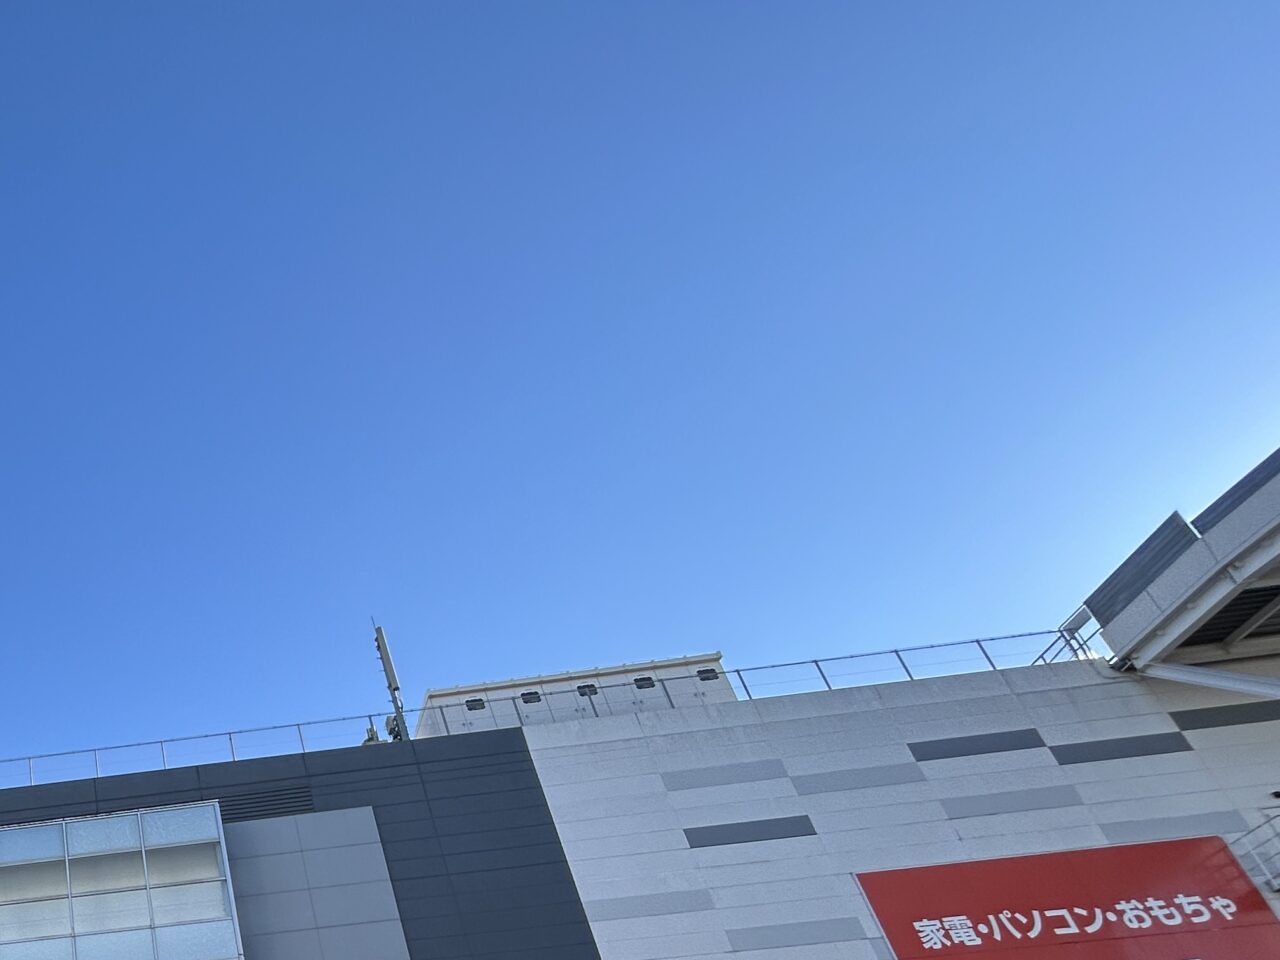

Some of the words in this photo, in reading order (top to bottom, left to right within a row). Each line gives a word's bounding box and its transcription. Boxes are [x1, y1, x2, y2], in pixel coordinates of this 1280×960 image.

[913, 894, 1237, 950] 家電・パソコン・おもちゃ
